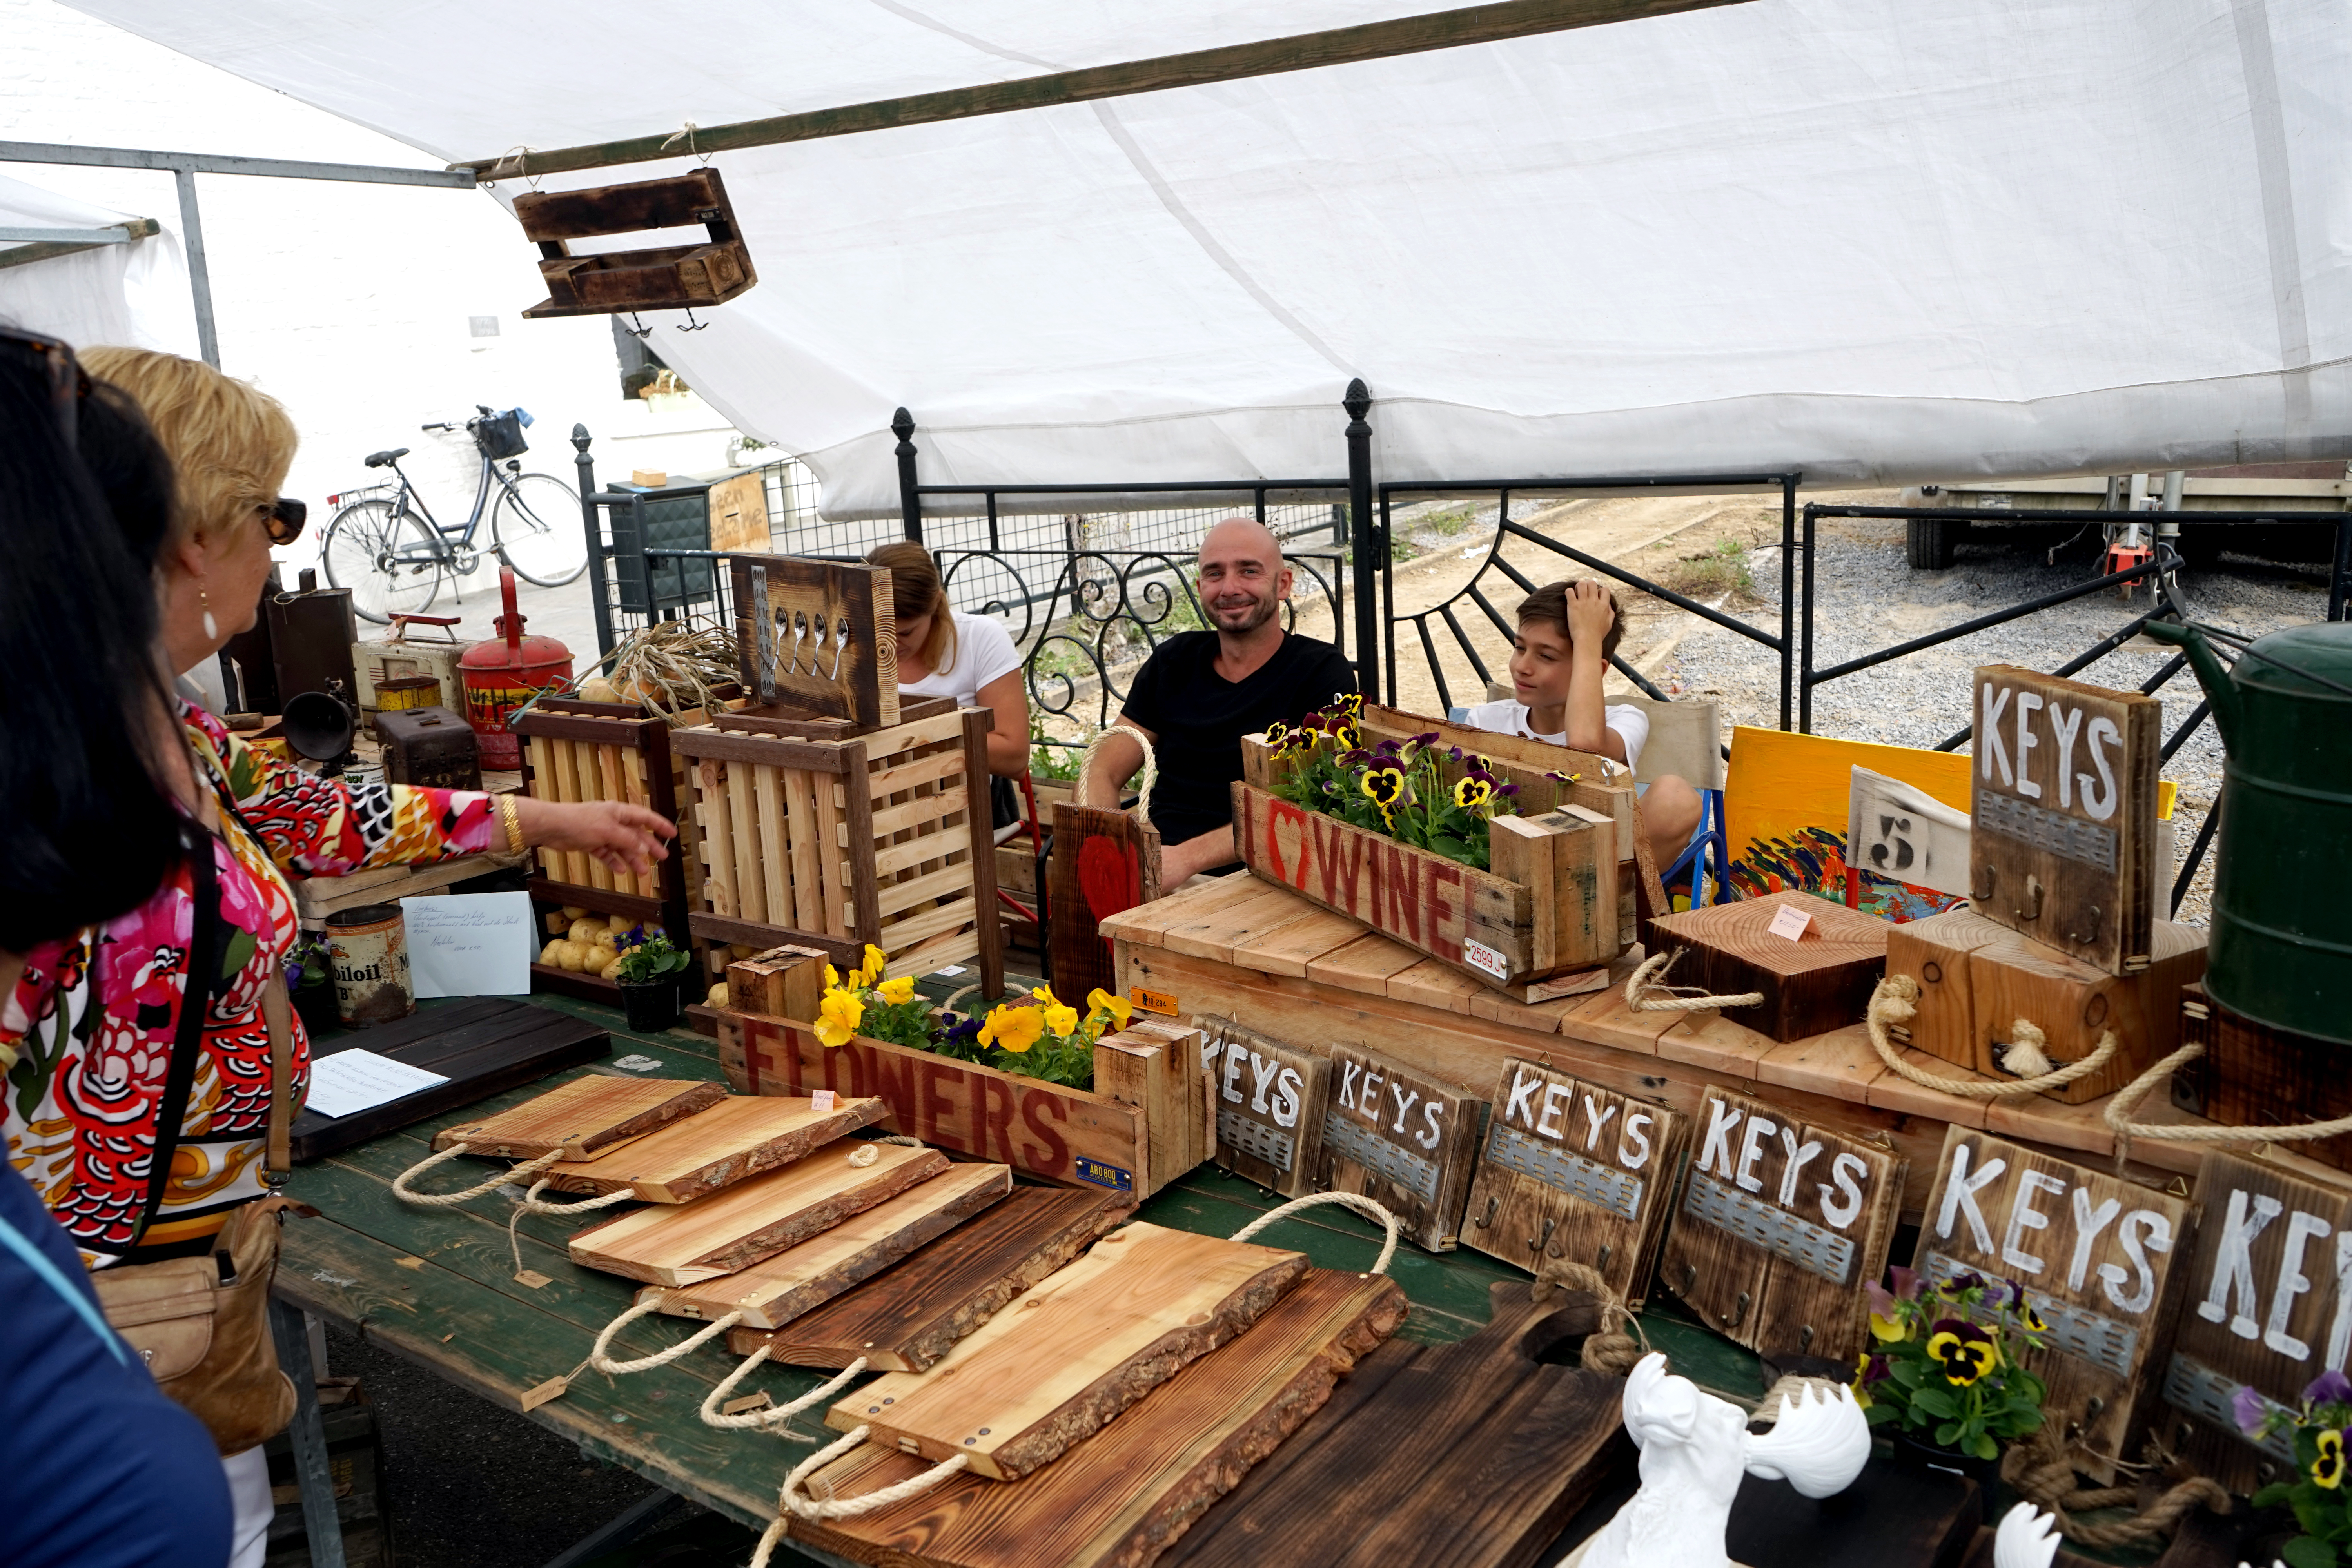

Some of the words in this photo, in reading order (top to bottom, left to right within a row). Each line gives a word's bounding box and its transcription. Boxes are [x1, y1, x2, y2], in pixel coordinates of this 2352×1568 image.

[1982, 682, 2123, 821] KEYS
[1243, 788, 1256, 866] I
[1312, 815, 1463, 963] WINE
[1871, 815, 1914, 871] 5
[1148, 998, 1167, 1008] 10-284
[1472, 945, 1492, 969] 2599
[1495, 958, 1500, 972] J
[744, 1018, 1069, 1178] FLOWERS
[1339, 1060, 1443, 1149] KEYS
[1505, 1070, 1654, 1169] KEYS
[1103, 1168, 1116, 1180] 800
[1694, 1097, 1868, 1229] KEYS
[1935, 1143, 2174, 1314] KEYS
